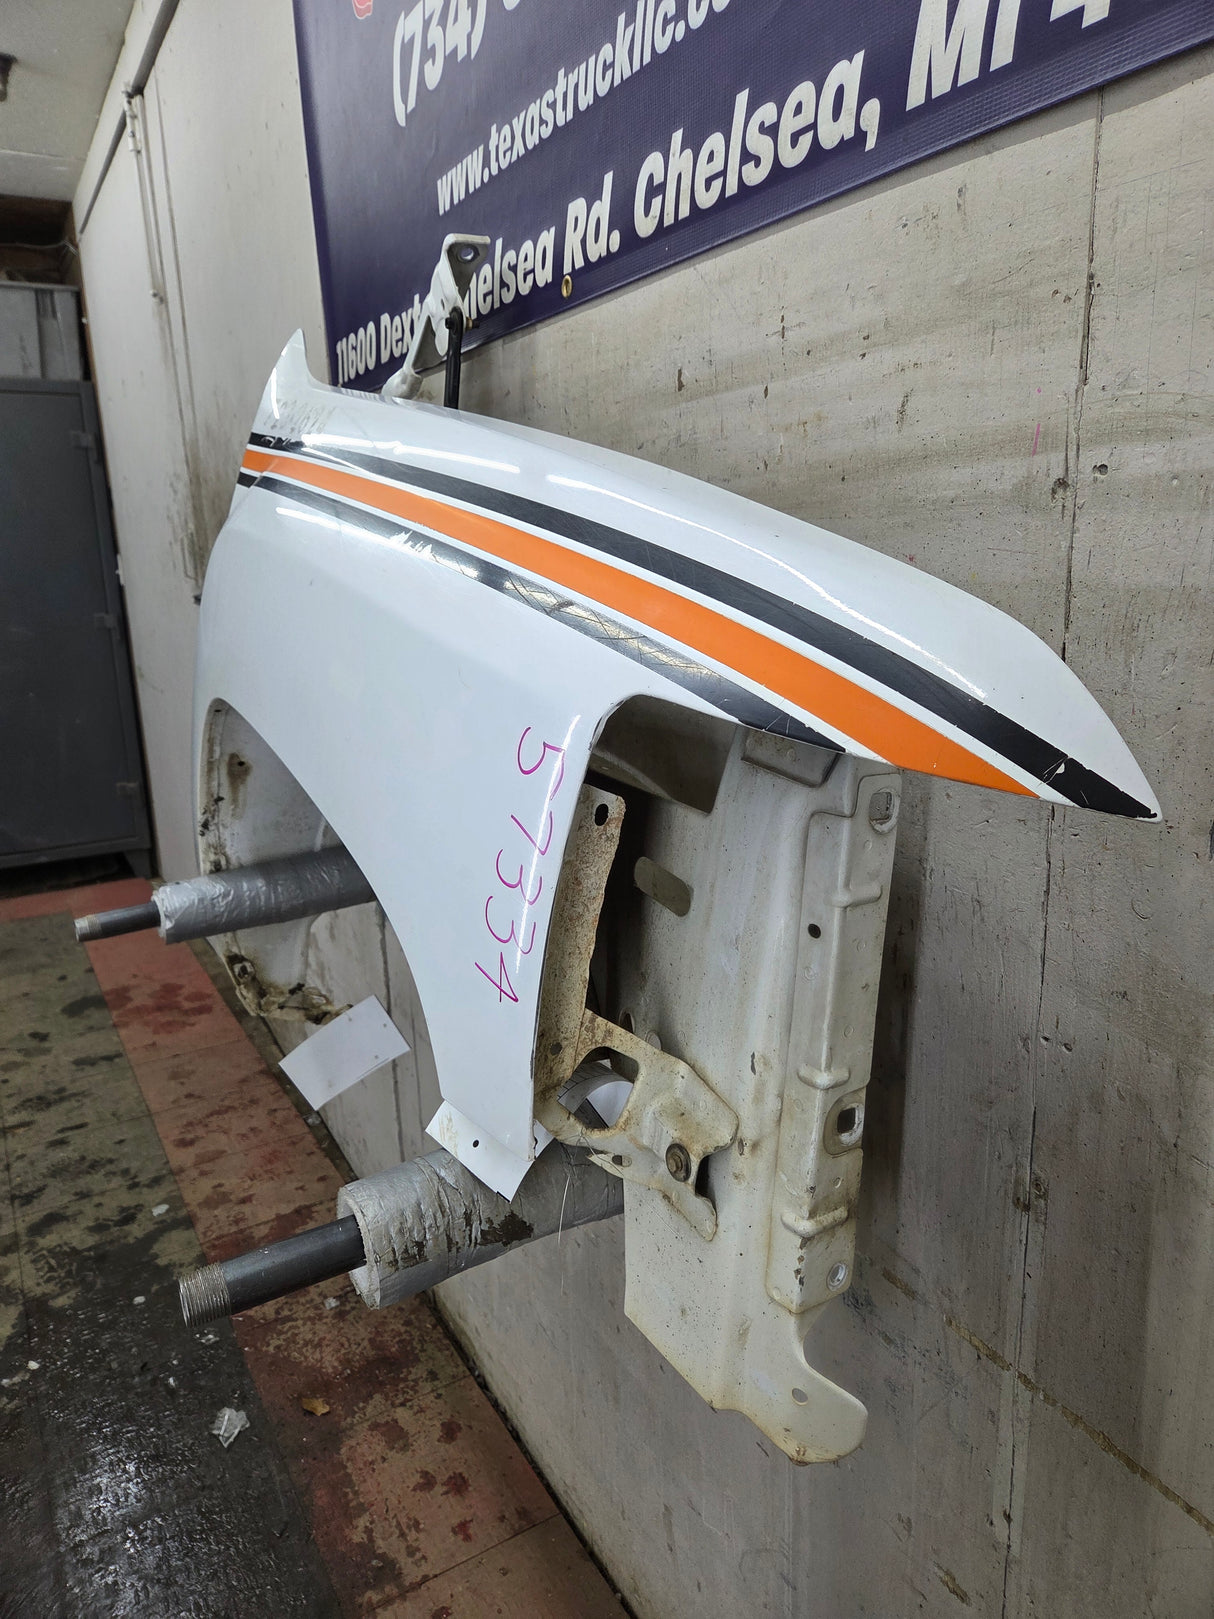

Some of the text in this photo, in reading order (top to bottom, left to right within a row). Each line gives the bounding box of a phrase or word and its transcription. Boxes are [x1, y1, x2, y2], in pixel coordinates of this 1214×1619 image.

[336, 320, 377, 384] 11600
[380, 293, 425, 364] Dext
[463, 226, 555, 319] elsea
[563, 171, 621, 275] Rd.
[633, 49, 881, 238] Chelsea,
[437, 0, 731, 216] www.texastruckllc.
[474, 726, 566, 1002] 57334
